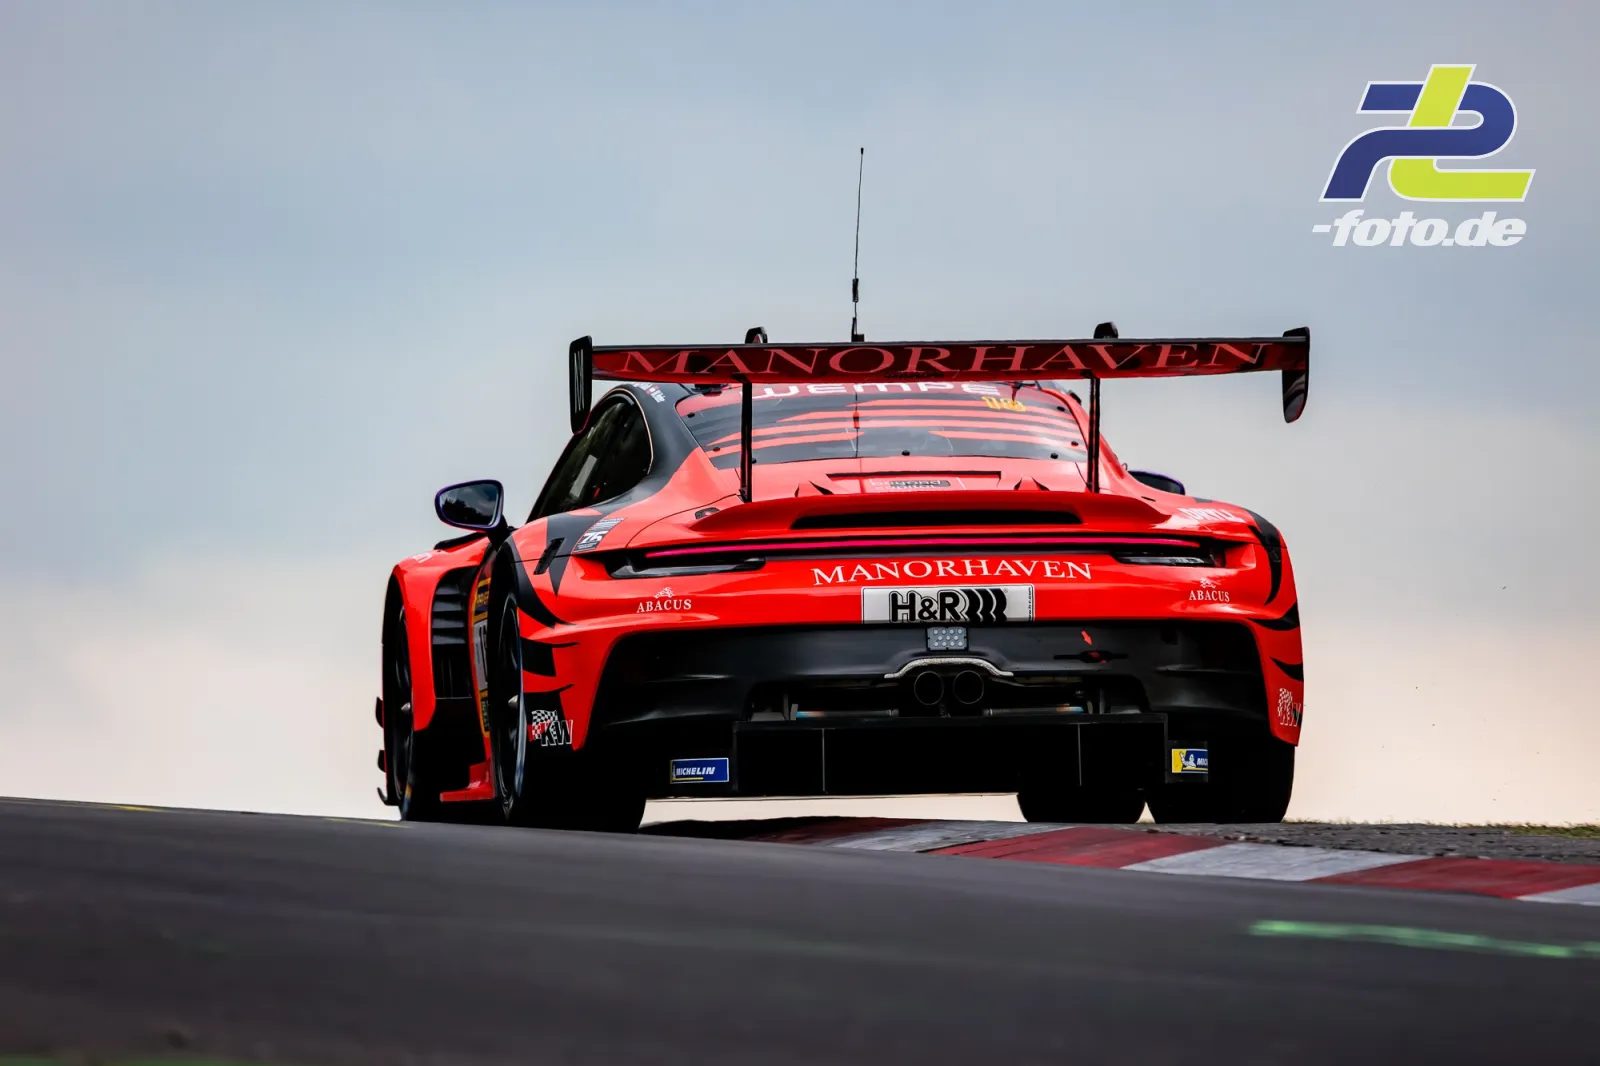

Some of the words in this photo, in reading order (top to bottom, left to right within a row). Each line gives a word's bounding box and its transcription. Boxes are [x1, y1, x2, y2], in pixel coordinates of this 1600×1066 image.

[616, 342, 1273, 374] MANORHAVEN
[812, 559, 1092, 586] MANORHAVEN
[636, 599, 692, 613] ABACUS
[889, 589, 972, 623] H&R
[1189, 590, 1230, 602] ABACUS
[541, 720, 574, 747] KW
[675, 766, 716, 776] MICHELIN
